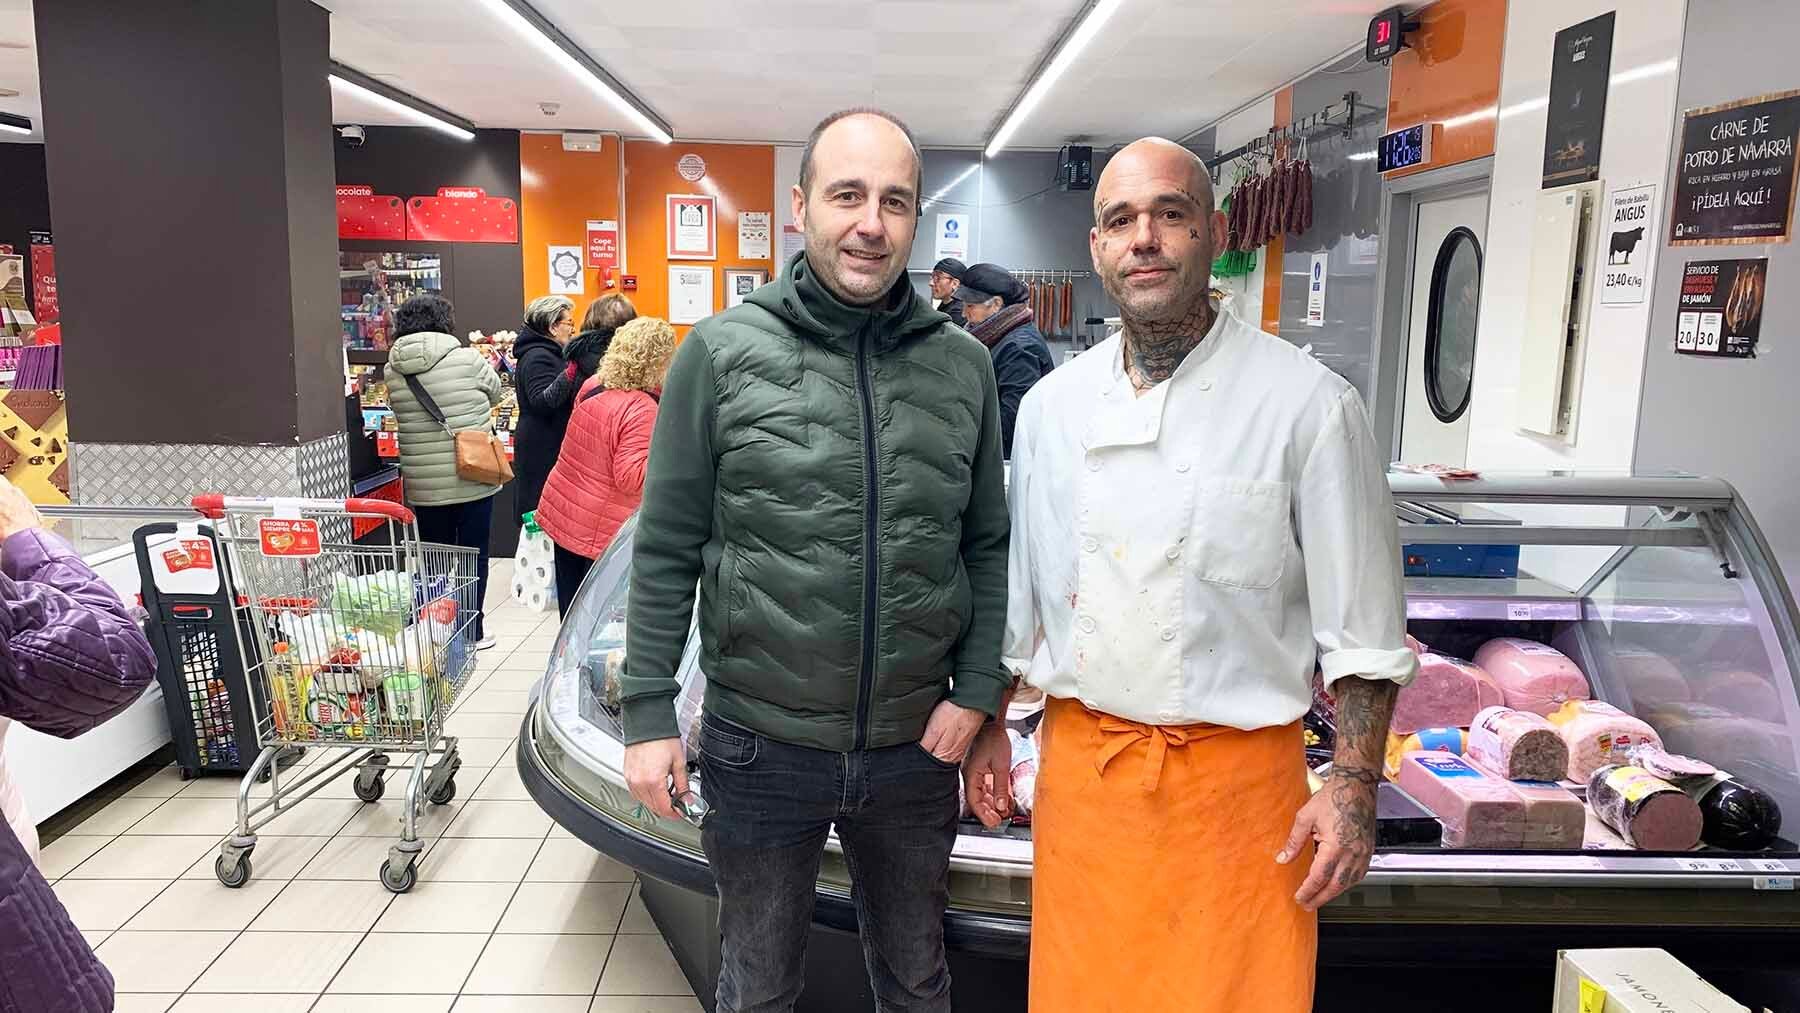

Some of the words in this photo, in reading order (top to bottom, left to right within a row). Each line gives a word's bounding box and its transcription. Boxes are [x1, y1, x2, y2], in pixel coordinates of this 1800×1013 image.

[1376, 21, 1391, 43] 31
[1710, 119, 1747, 141] CARNE
[1752, 116, 1770, 135] DE
[1684, 151, 1718, 173] POTRO
[1721, 147, 1735, 164] DE
[1738, 136, 1792, 162] NAVARRA
[1751, 168, 1761, 178] EN
[1691, 191, 1729, 212] ¡PÍDELA
[1614, 205, 1646, 222] ANGUS
[593, 237, 612, 245] Coge
[1711, 265, 1719, 274] DE
[1606, 273, 1627, 288] 23,40
[1682, 295, 1690, 303] DE
